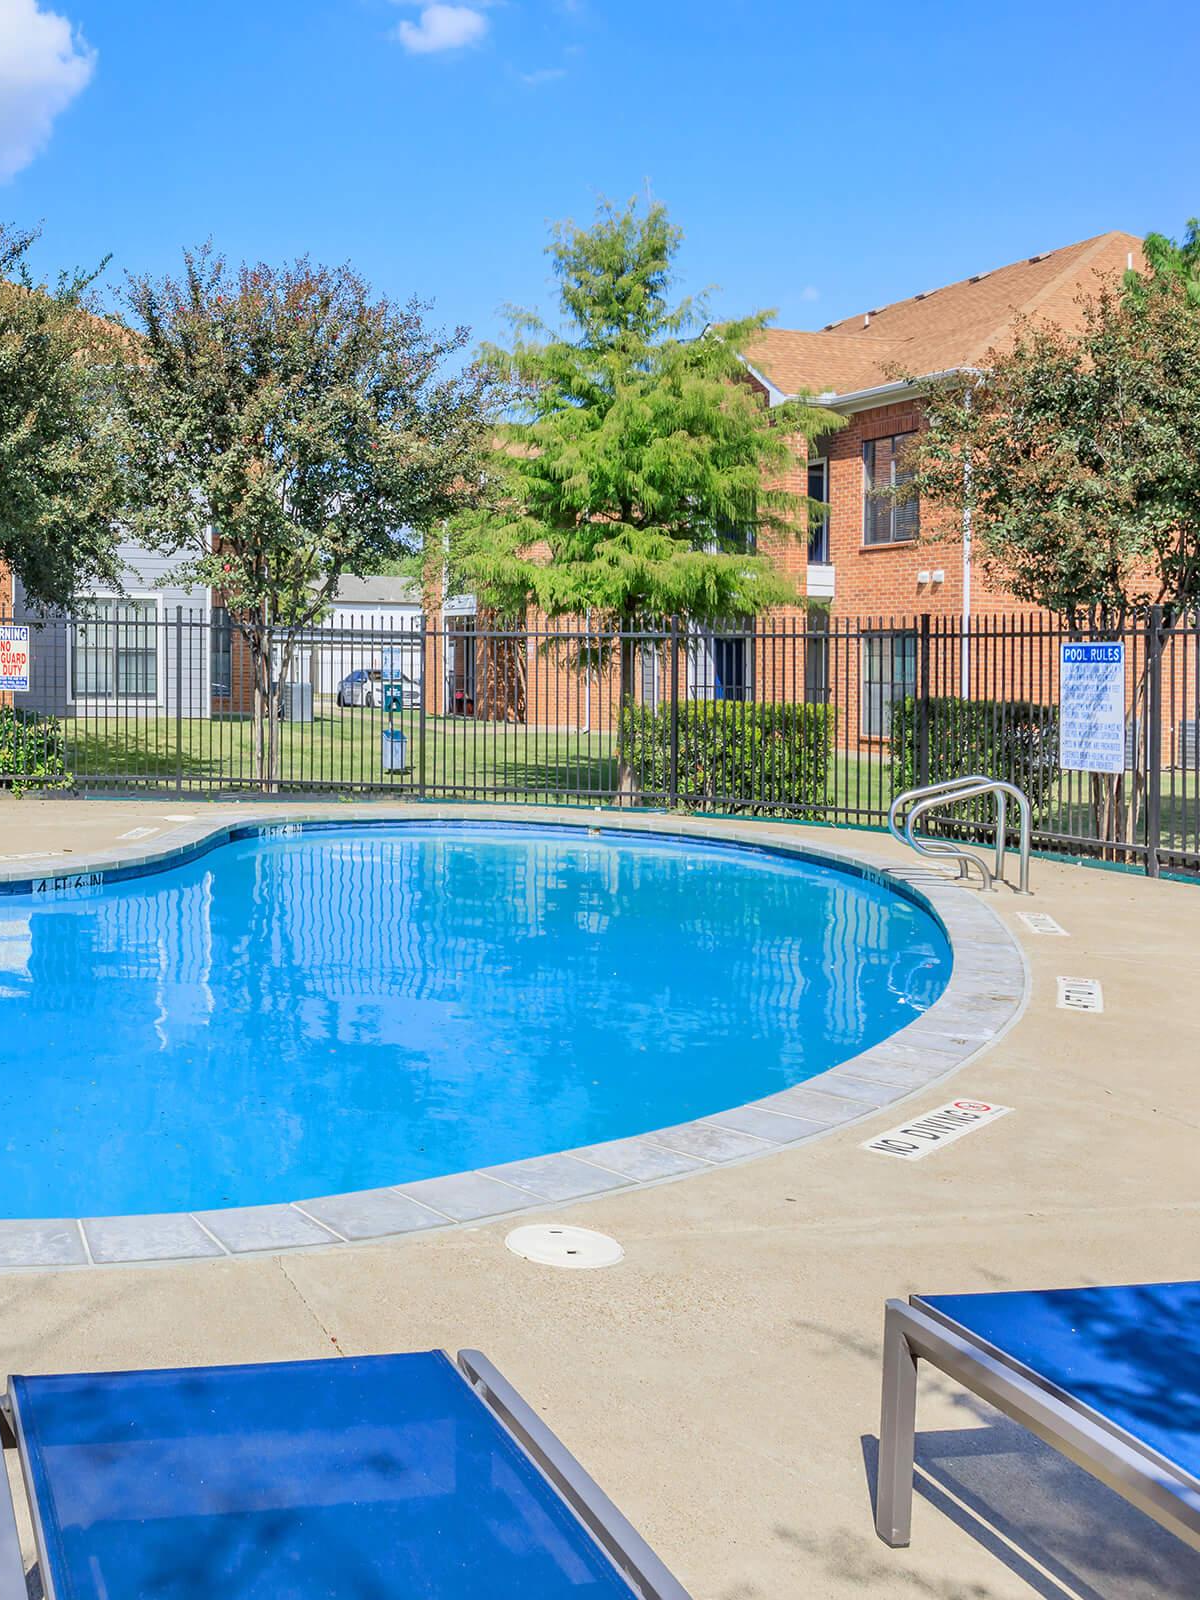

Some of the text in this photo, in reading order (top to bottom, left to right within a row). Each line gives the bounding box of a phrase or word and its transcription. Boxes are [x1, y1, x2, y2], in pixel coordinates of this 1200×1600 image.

[0, 641, 11, 652] NO
[1065, 648, 1120, 661] POOL RULES
[3, 664, 23, 676] DUTY
[869, 1109, 981, 1156] NO DIVING
